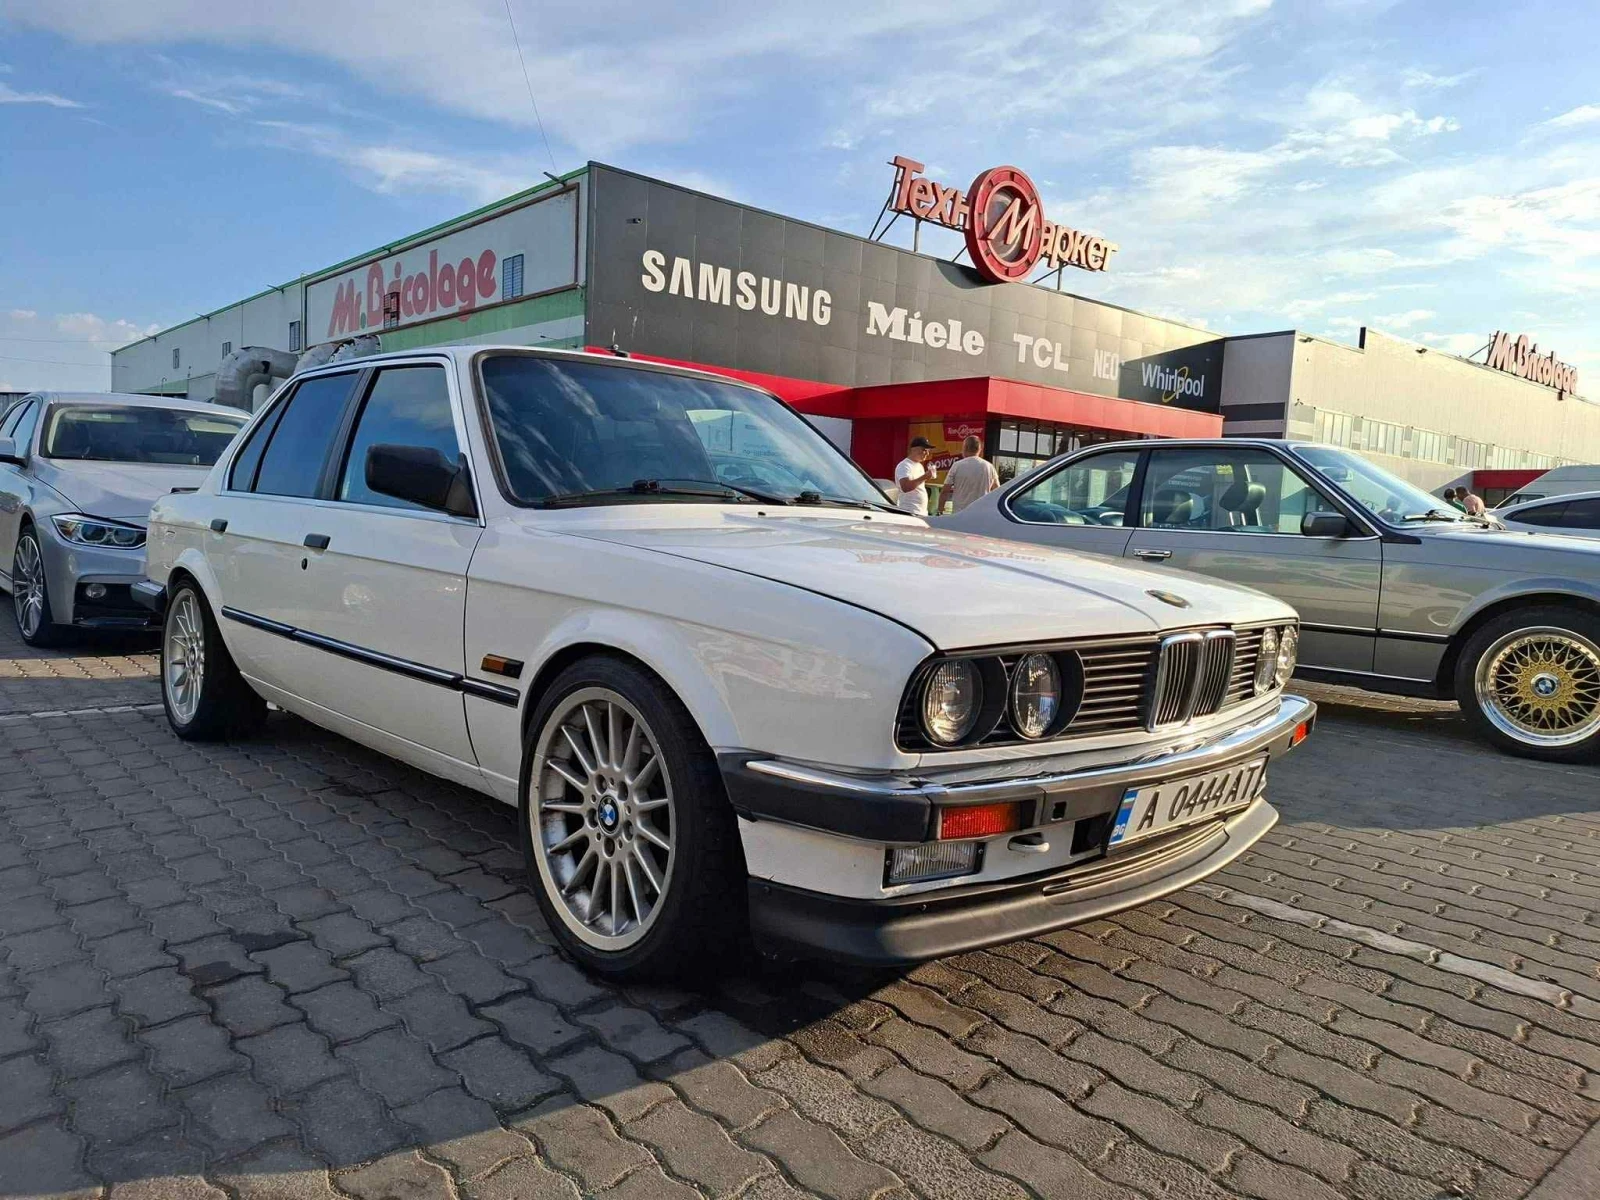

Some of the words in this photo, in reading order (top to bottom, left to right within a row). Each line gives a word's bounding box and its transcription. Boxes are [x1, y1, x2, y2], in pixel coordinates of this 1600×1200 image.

[641, 249, 832, 326] SAMSUNG
[866, 300, 985, 356] Miele
[1013, 332, 1069, 372] TCL
[1093, 348, 1120, 381] NEO
[1141, 361, 1205, 400] Whirlpool
[1136, 790, 1160, 832] A
